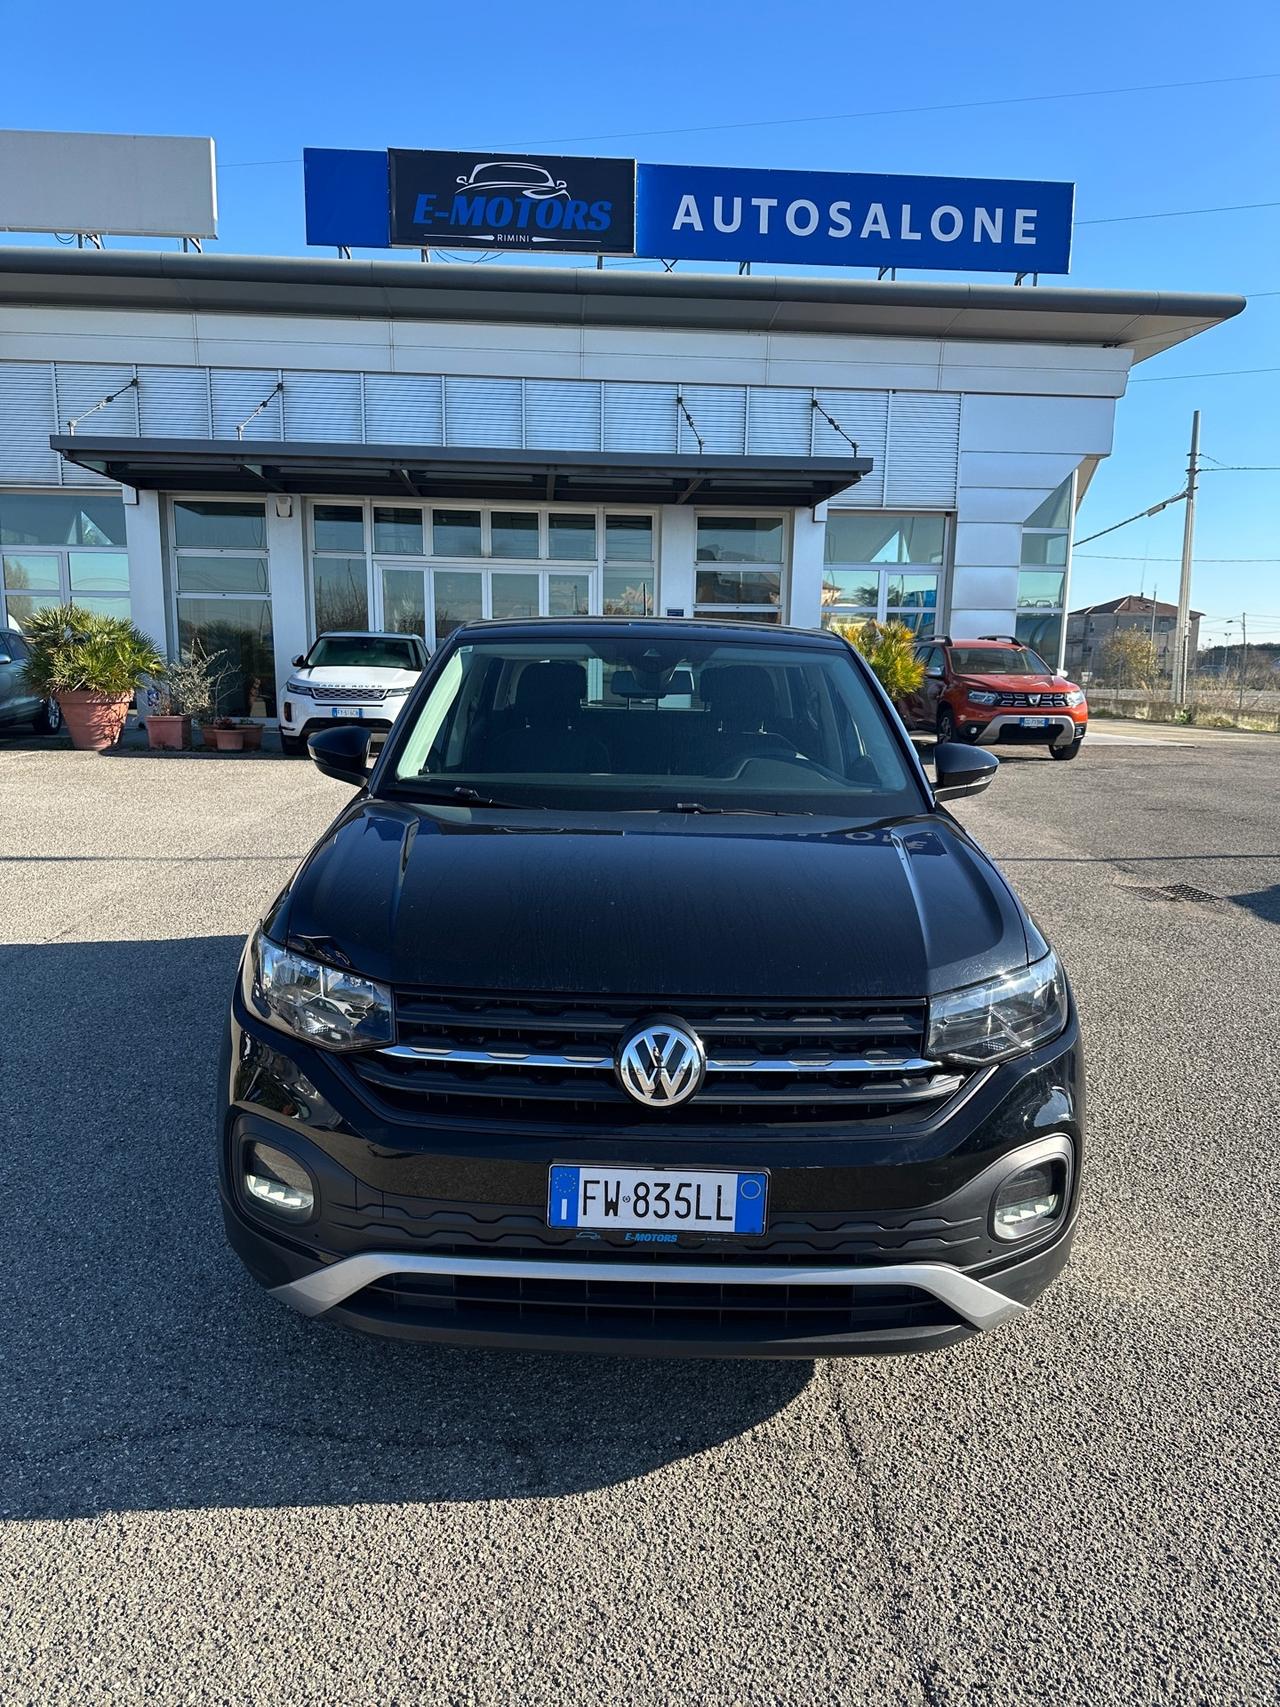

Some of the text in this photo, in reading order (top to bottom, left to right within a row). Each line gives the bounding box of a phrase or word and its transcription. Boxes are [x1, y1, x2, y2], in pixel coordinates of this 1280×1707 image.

[413, 193, 613, 232] E-MOTORS
[672, 194, 1038, 245] AUTOSALONE
[497, 233, 531, 243] RIMINI
[582, 1179, 621, 1217] FW
[632, 1181, 734, 1221] 835LL
[624, 1232, 679, 1244] E-MOTORS
